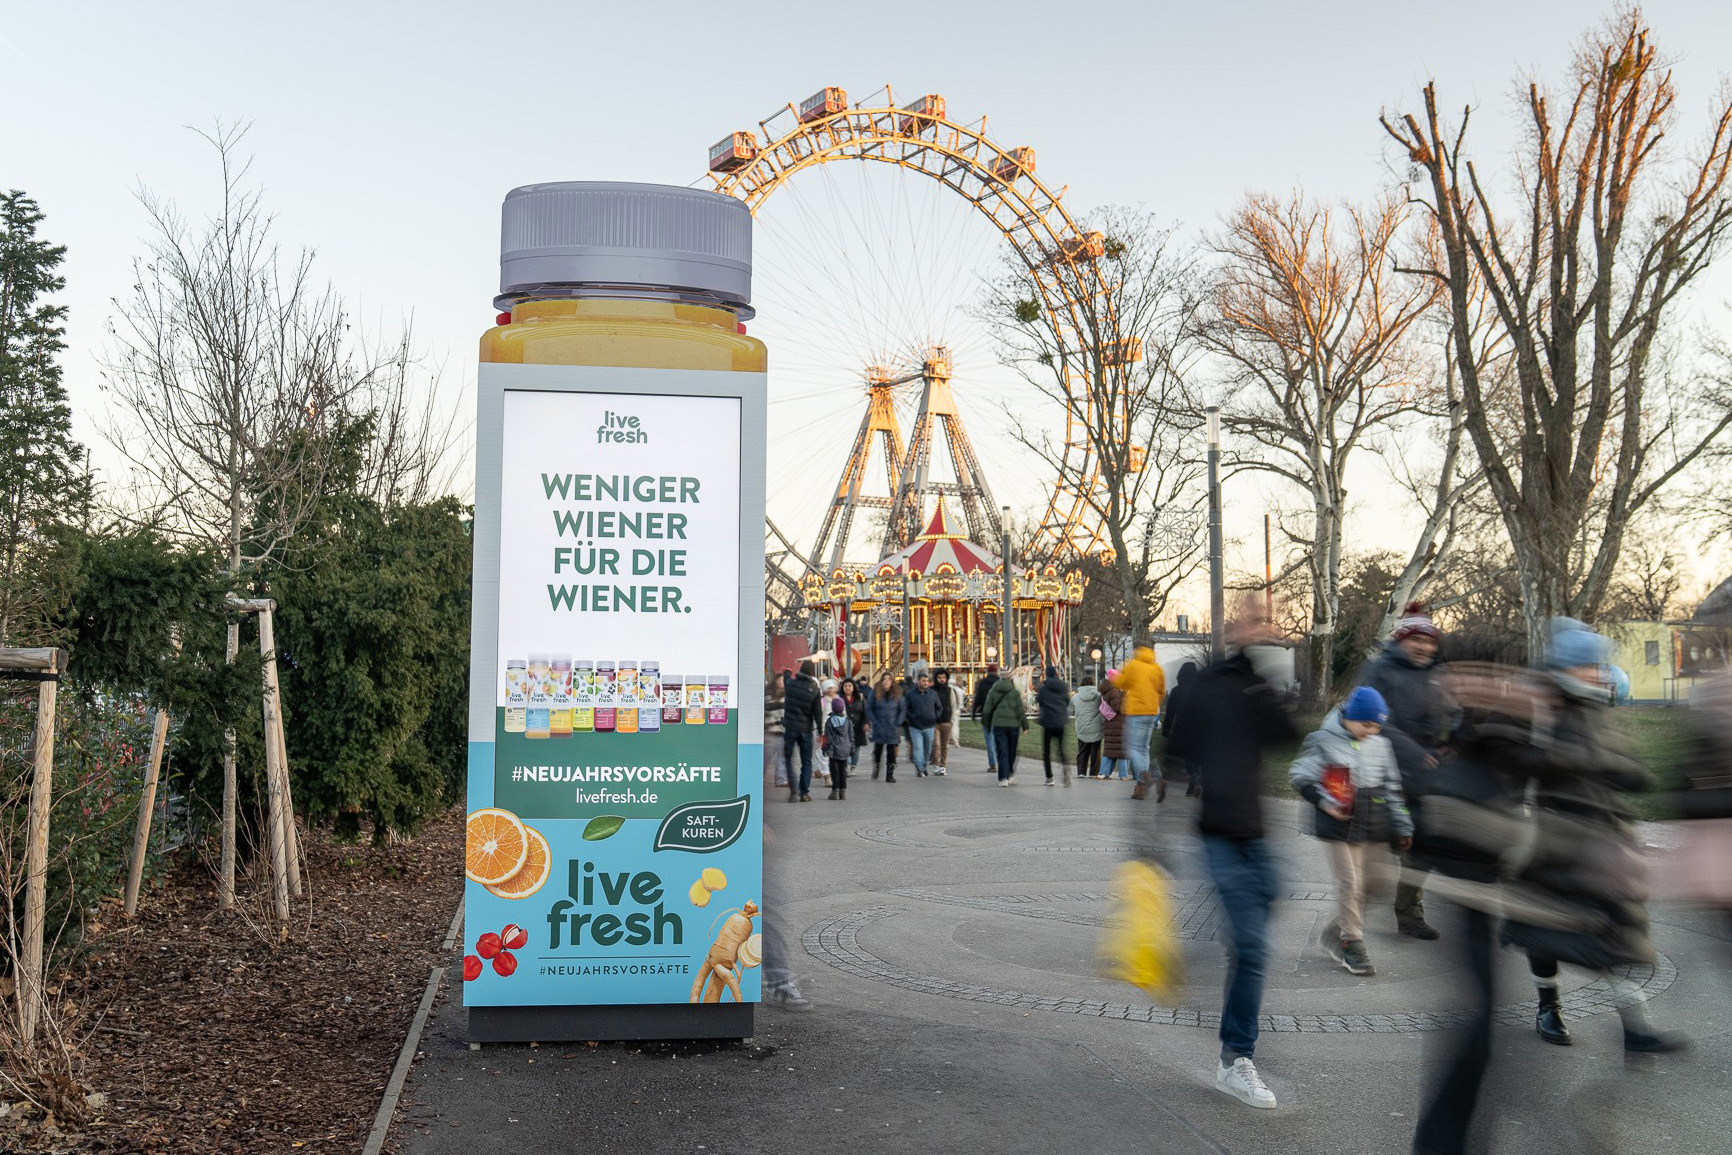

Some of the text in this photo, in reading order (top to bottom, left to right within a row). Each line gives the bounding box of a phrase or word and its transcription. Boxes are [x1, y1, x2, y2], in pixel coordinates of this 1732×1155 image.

[604, 410, 641, 429] live
[596, 425, 648, 444] fresh
[541, 473, 701, 503] WENIGER
[553, 510, 688, 540] WIENER
[554, 540, 687, 576] FÜR DIE
[547, 584, 692, 614] WIENER.
[511, 763, 721, 783] #NEUJAHRSVORSÄFTE
[576, 788, 658, 804] livefresh.de
[686, 815, 720, 826] SAFT-
[681, 828, 724, 839] KUREN
[568, 859, 664, 906] live
[547, 900, 683, 950] fresh
[539, 963, 690, 976] #NEUJAHRSVORSÄFTE
